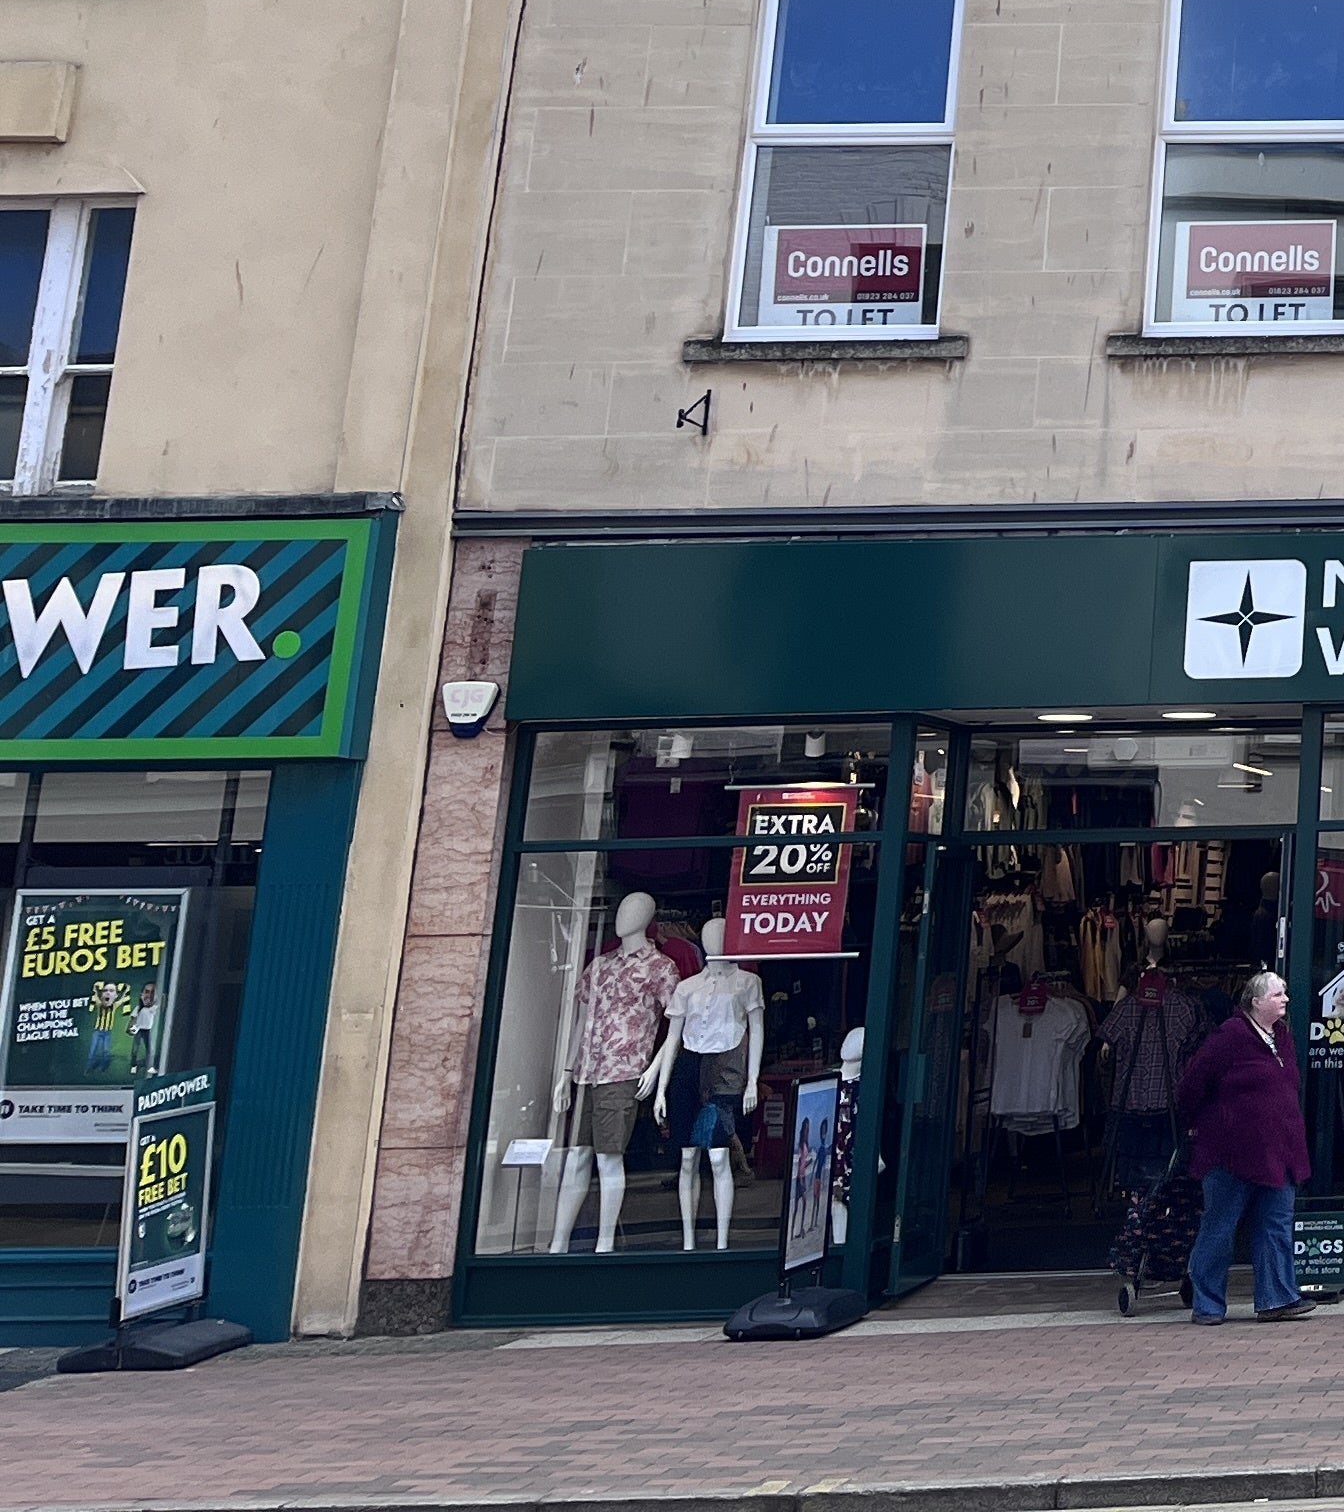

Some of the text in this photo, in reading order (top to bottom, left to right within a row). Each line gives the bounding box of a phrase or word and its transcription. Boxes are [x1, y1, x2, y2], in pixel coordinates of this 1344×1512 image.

[787, 249, 910, 278] Connells
[1200, 245, 1320, 273] Connells
[754, 813, 835, 835] EXTRA
[750, 843, 832, 874] 20% OFF
[742, 893, 832, 906] EVERYTHING
[26, 915, 56, 926] GET A
[740, 911, 829, 934] TODAY
[24, 919, 124, 952] £5 FREE
[22, 941, 166, 978] EUROS BET
[20, 997, 90, 1011] WHEN YOU BET
[31, 1011, 47, 1021] ON
[49, 1009, 67, 1019] THE
[17, 1018, 74, 1031] CHAMPIONS
[16, 1027, 79, 1042] LEAGUE FINAL
[1309, 1047, 1326, 1056] are
[1311, 1058, 1321, 1068] in
[1324, 1057, 1343, 1068] this
[18, 1104, 123, 1114] TAKE TIME TO THINK
[139, 1133, 187, 1187] £10
[138, 1181, 165, 1208] FREE
[167, 1172, 188, 1196] BET
[1308, 1256, 1343, 1265] welcome
